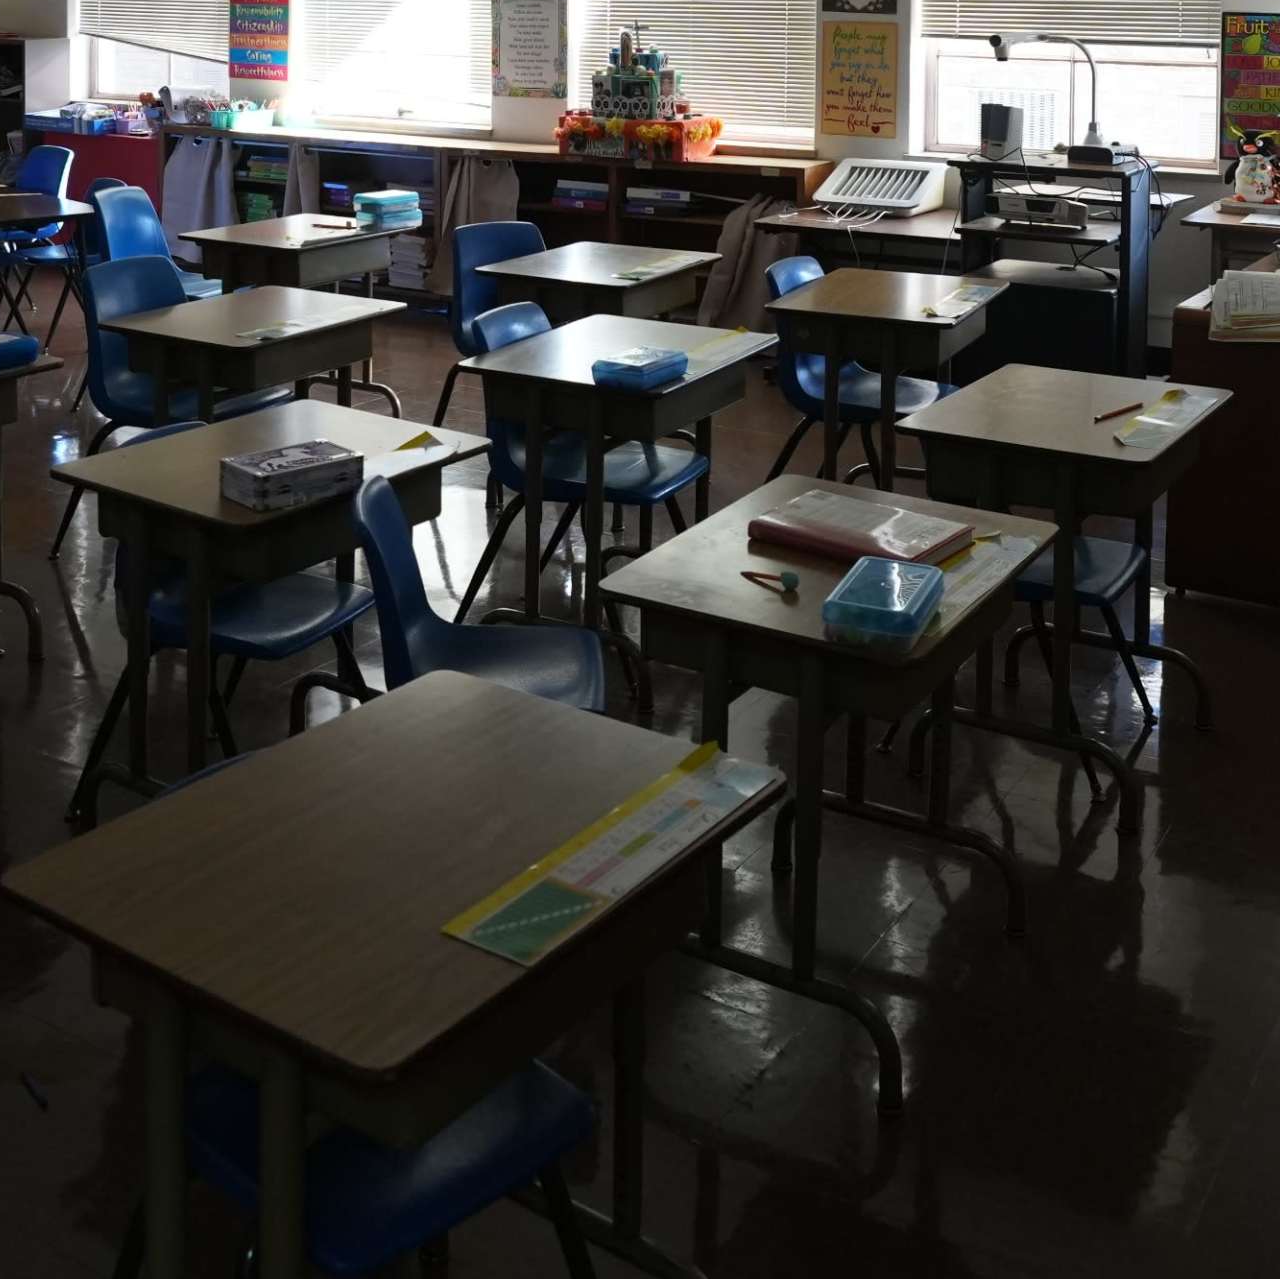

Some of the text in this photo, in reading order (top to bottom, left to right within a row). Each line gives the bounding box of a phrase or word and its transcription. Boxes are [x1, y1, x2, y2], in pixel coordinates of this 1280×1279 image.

[235, 4, 283, 19] Responsibility
[236, 19, 284, 34] Citizenship
[1225, 15, 1269, 33] Fruit
[246, 50, 272, 64] Caring
[847, 113, 870, 132] feel
